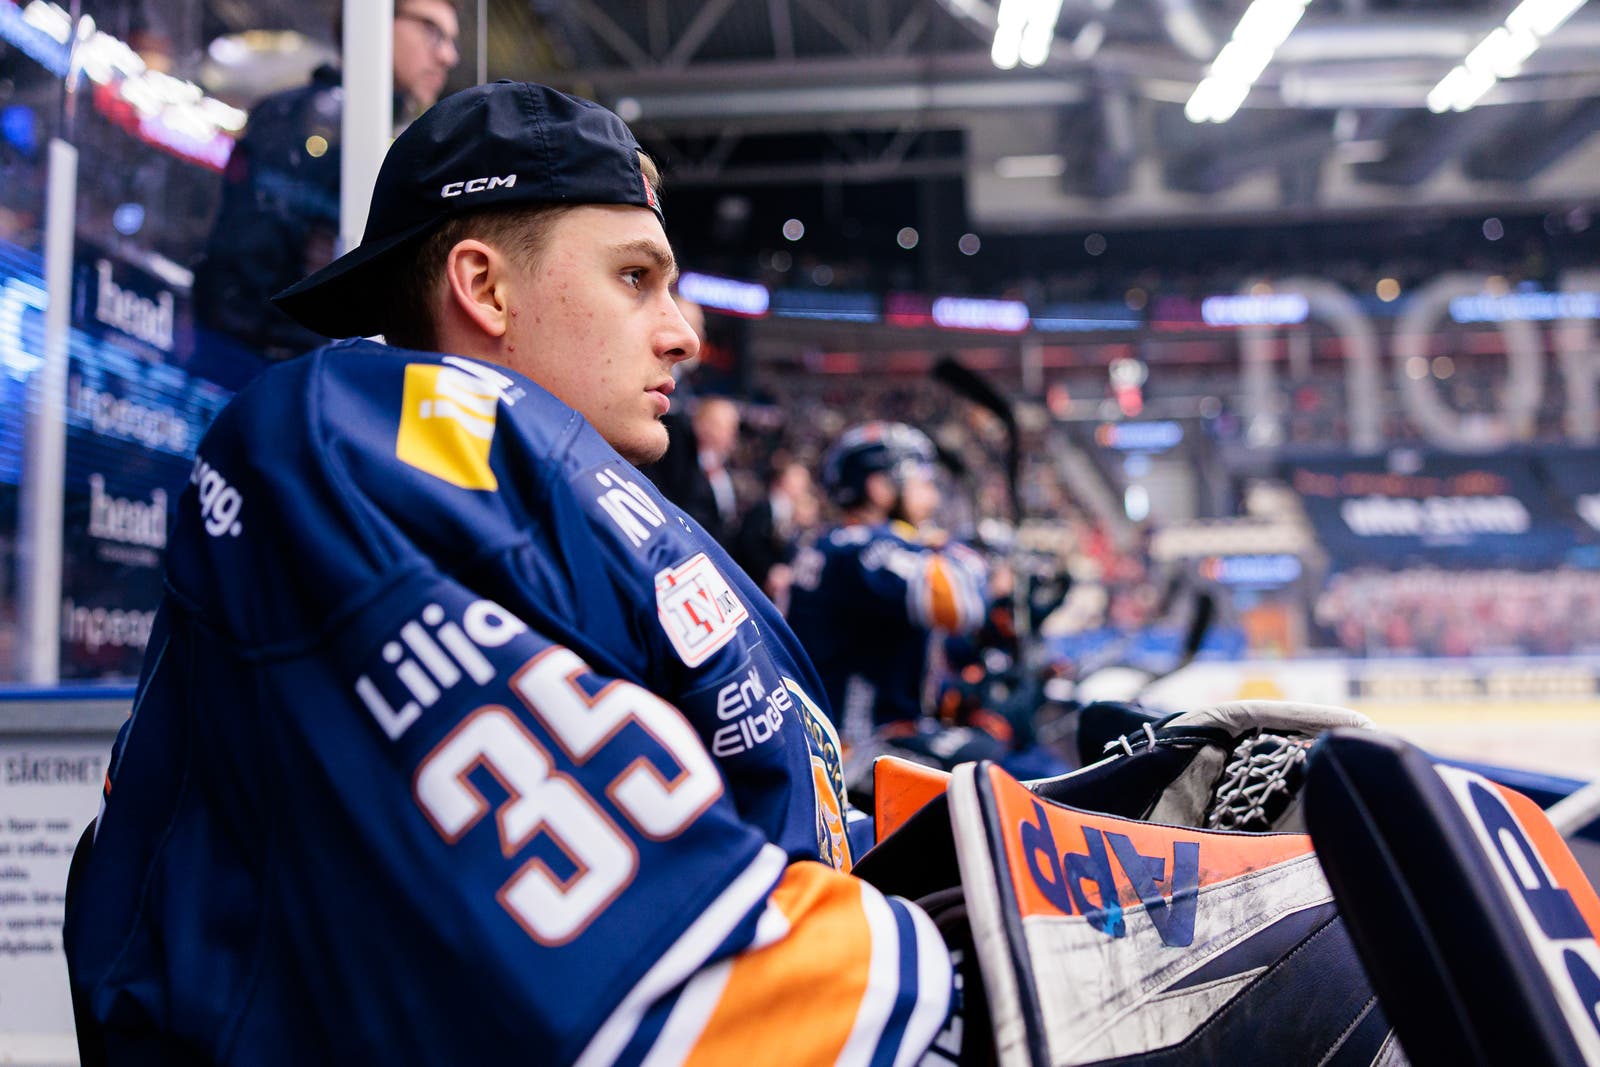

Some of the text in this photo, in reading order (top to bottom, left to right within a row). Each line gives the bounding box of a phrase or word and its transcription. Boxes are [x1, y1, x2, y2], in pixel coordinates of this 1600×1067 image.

[441, 174, 517, 198] CCM
[356, 599, 528, 741] Lilja
[411, 645, 724, 947] 35
